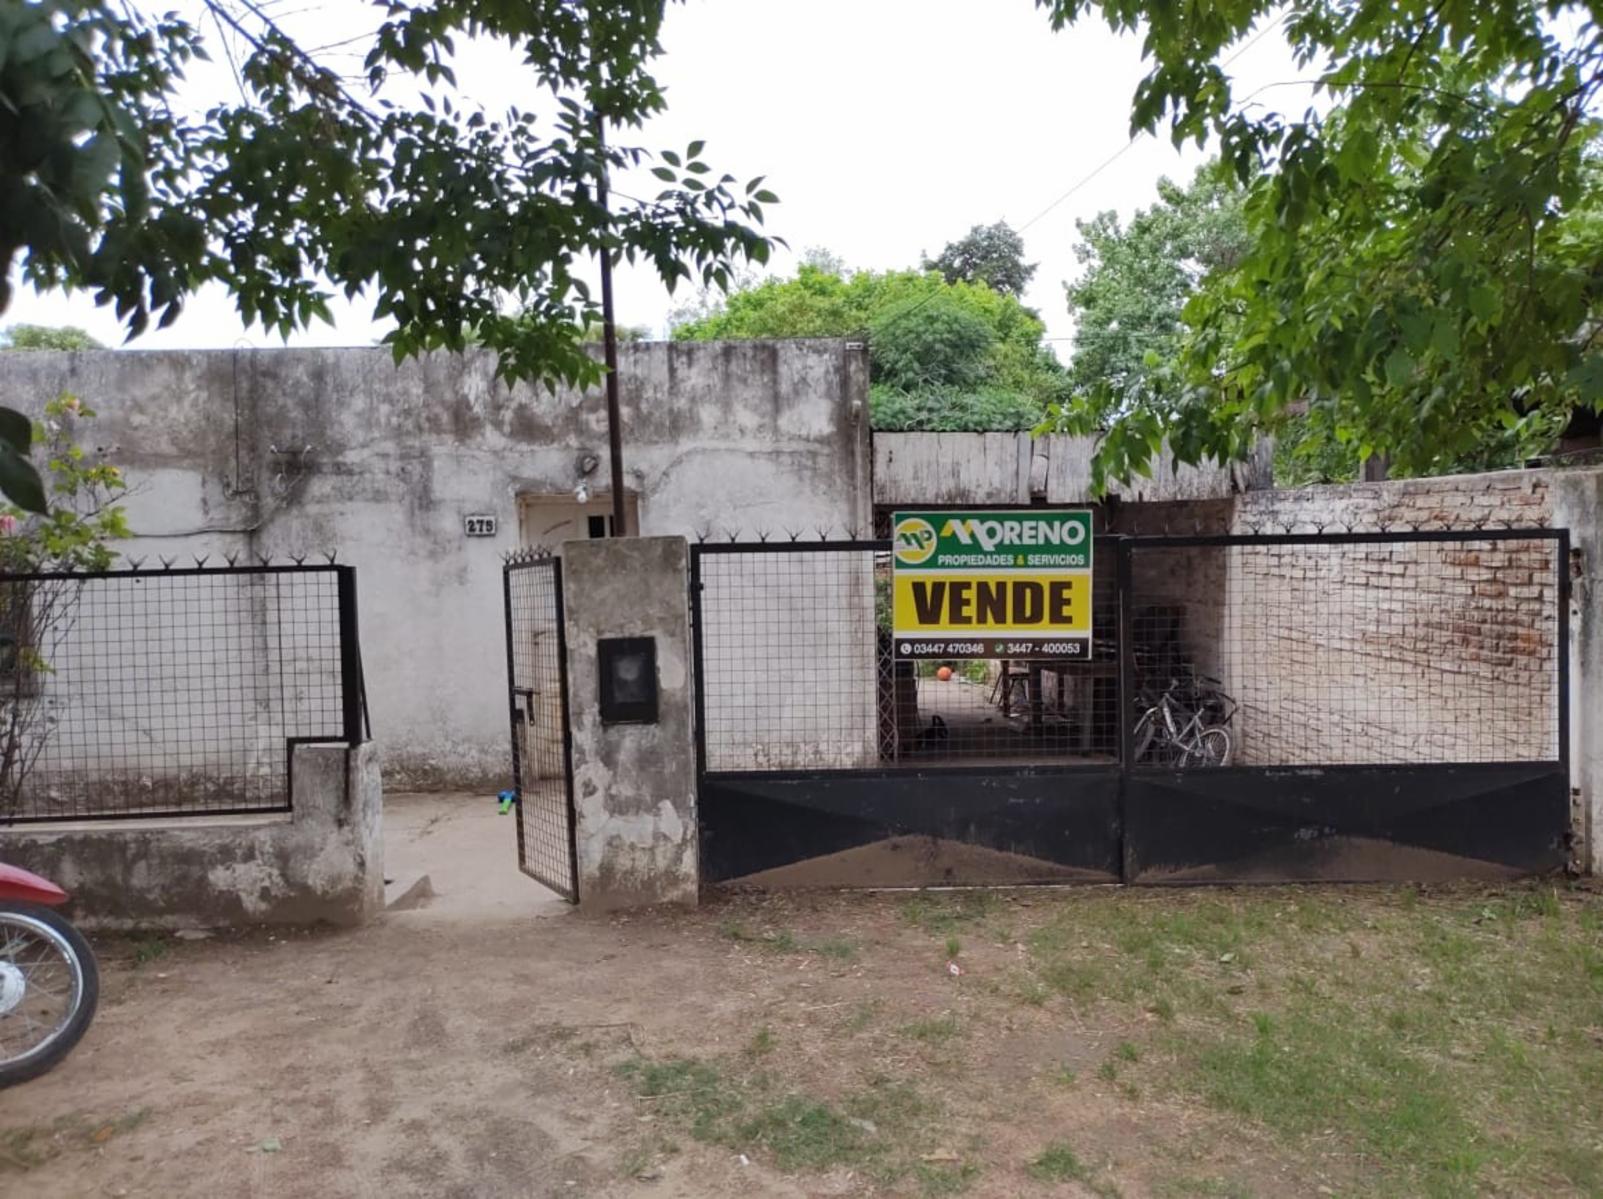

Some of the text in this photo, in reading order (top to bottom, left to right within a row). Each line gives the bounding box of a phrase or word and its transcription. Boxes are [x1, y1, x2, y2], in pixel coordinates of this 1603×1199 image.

[939, 518, 1086, 551] MORENO
[937, 554, 1015, 566] PROPIEDADES
[1027, 554, 1085, 565] SERVICIOS
[911, 581, 1073, 625] VENDE
[913, 643, 985, 654] 03447 470346
[1006, 643, 1033, 654] 3447
[1041, 643, 1081, 654] 400053
